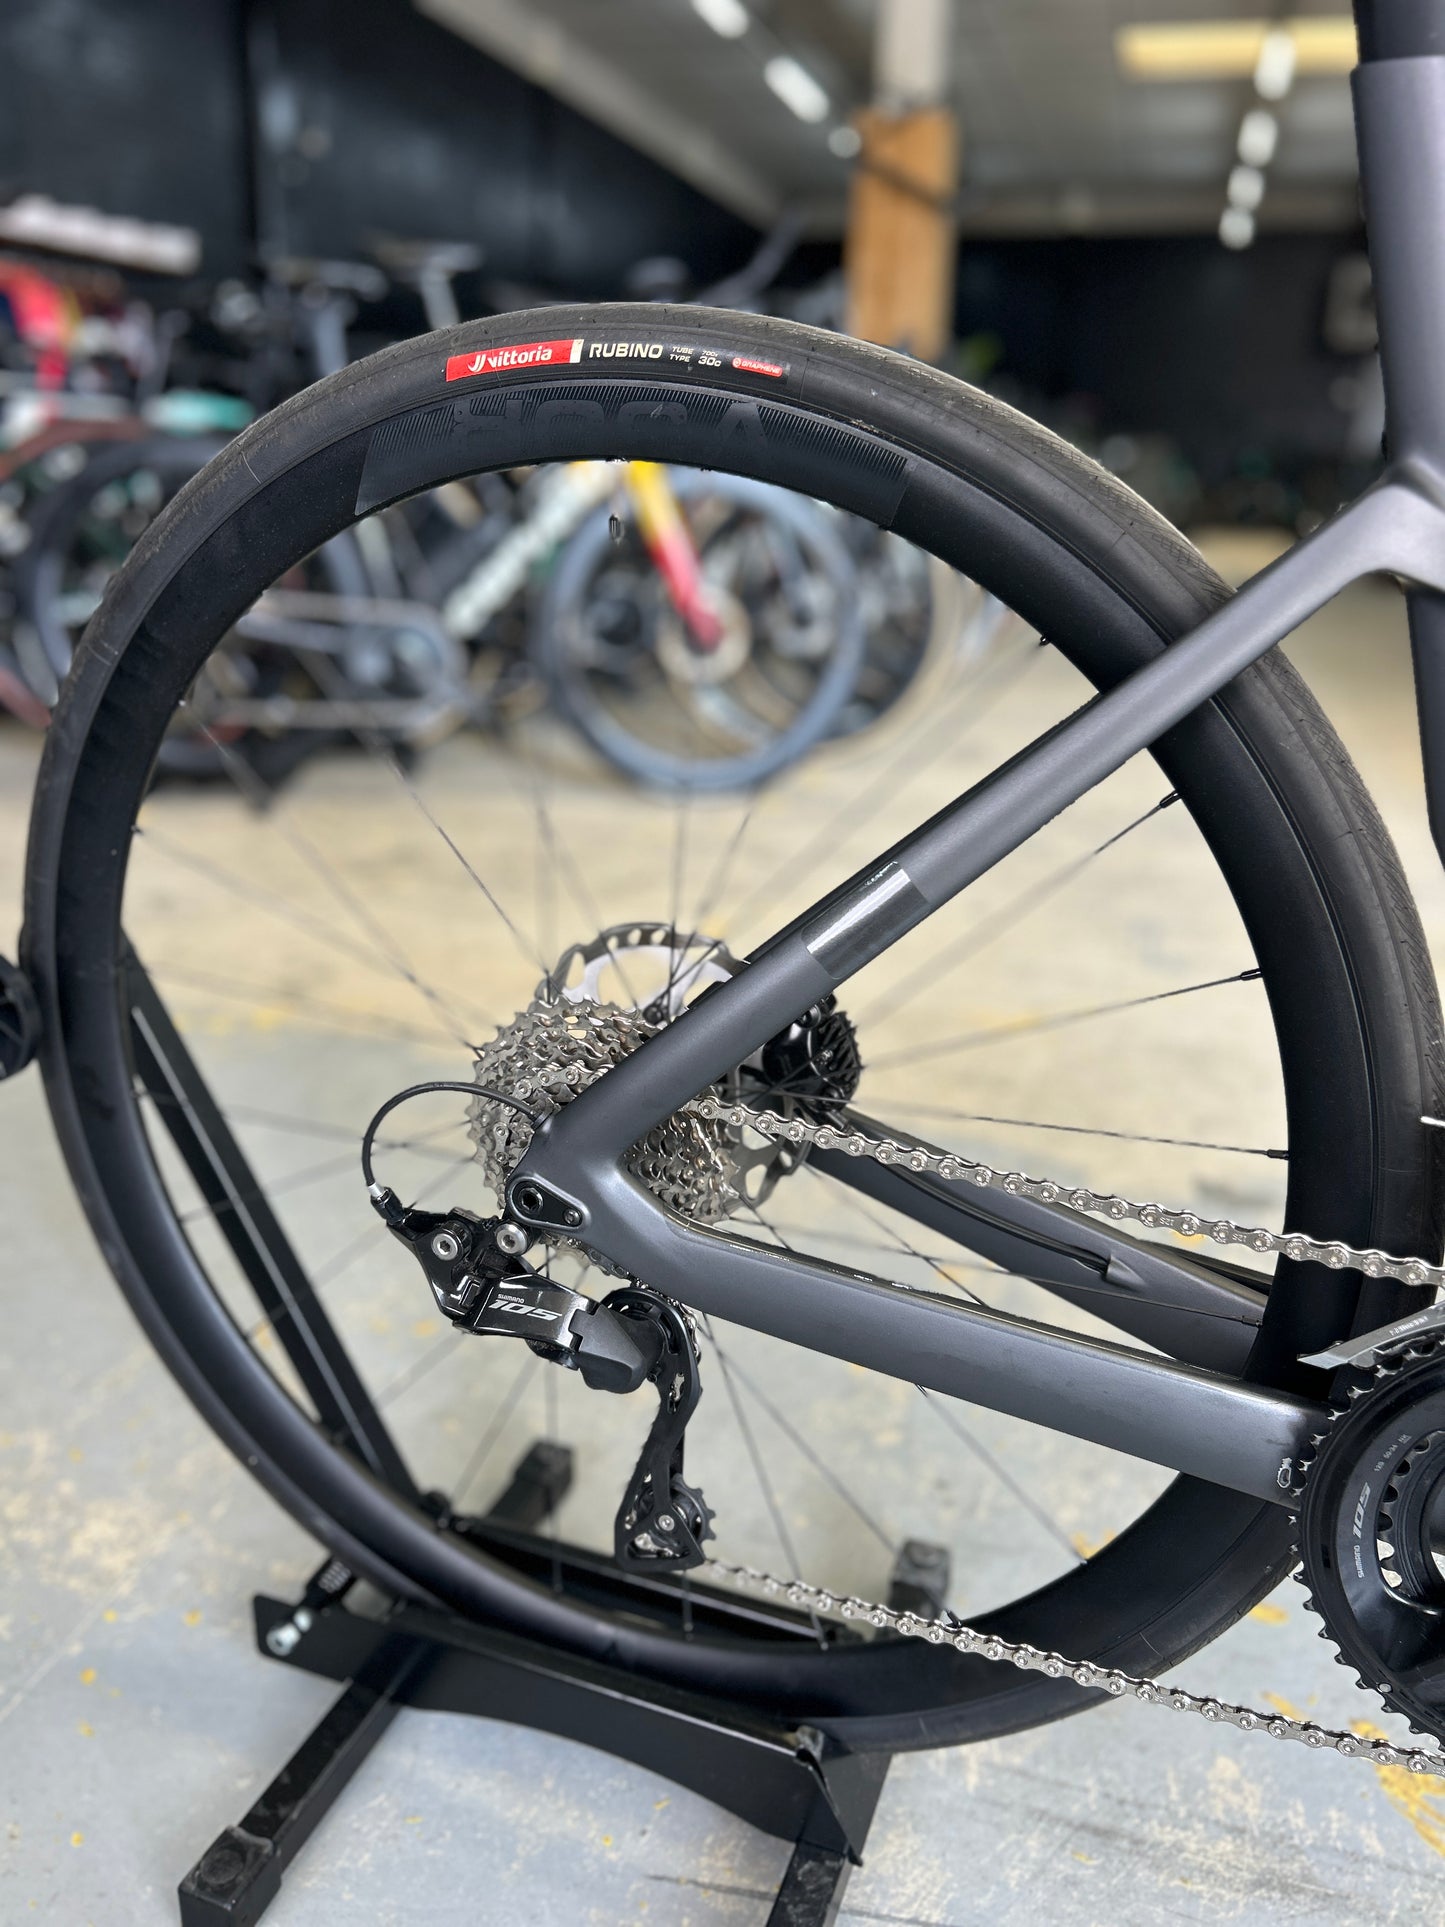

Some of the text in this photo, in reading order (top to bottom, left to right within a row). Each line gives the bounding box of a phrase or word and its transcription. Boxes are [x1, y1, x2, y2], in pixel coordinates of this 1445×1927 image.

[487, 343, 663, 369] vittoria RUBINO
[669, 354, 690, 363] TYPE
[672, 346, 694, 355] TUBE
[741, 360, 780, 374] GRAPHENE
[498, 1293, 525, 1304] SHIMANO
[488, 1299, 563, 1321] 105
[1352, 1482, 1371, 1539] 105
[1353, 1544, 1365, 1578] SHIMANO
